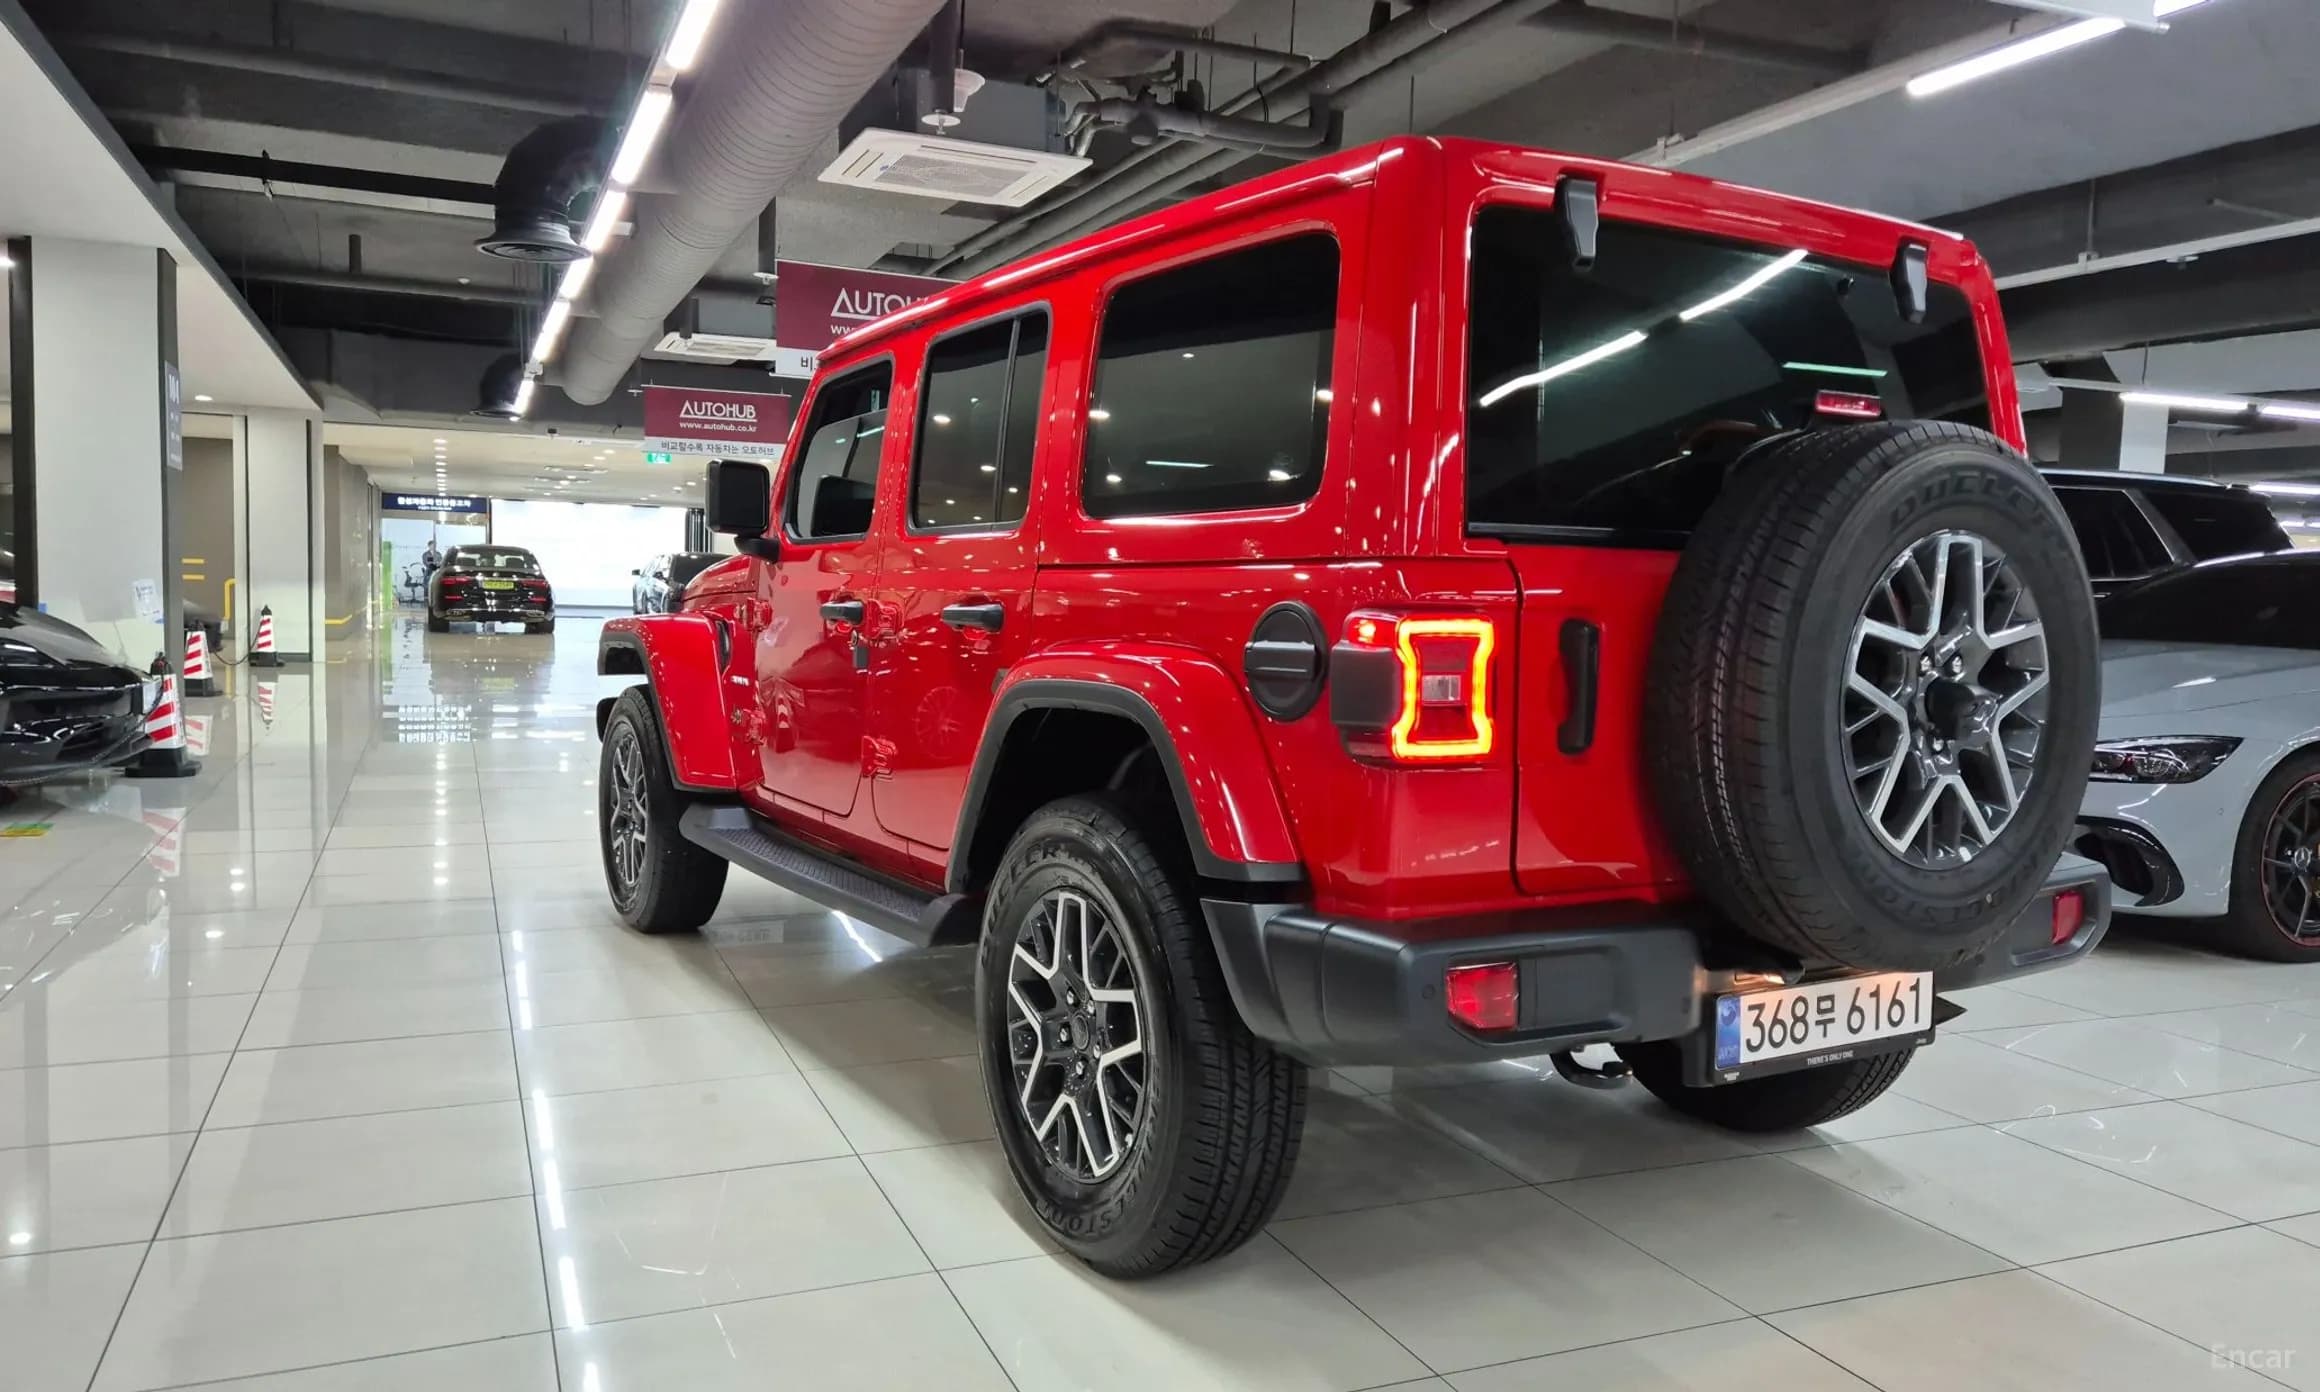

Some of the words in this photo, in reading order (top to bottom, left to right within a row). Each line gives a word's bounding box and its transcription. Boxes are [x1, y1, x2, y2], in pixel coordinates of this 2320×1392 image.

[680, 400, 757, 420] AUTOHUB
[679, 422, 757, 432] www.autohub.co.kr
[1745, 994, 1836, 1053] 368무
[1846, 977, 1921, 1035] 6161
